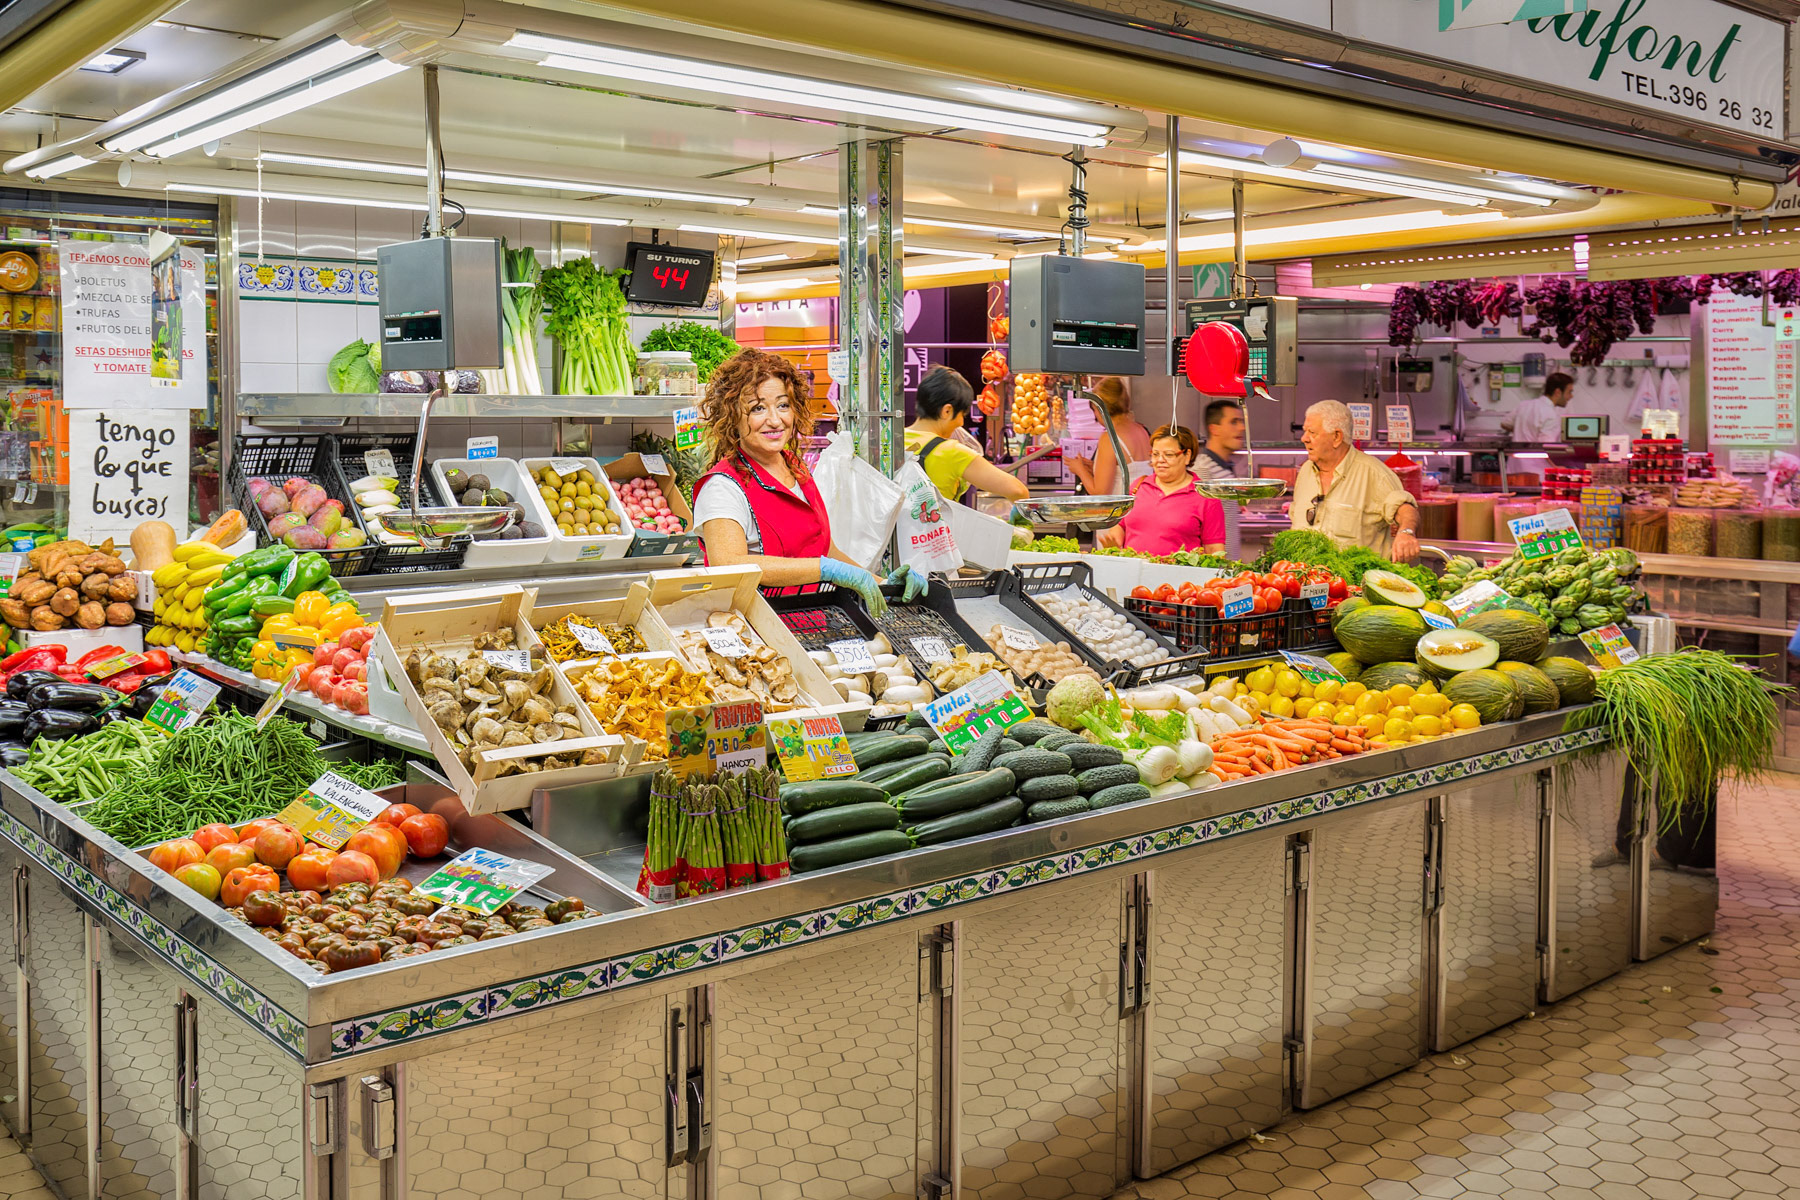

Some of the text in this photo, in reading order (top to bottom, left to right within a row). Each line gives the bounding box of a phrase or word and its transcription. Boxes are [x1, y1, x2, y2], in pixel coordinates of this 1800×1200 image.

[1621, 71, 1774, 130] TEL.396 26 32
[70, 253, 120, 264] TENEMOS
[665, 256, 700, 266] TURNO
[80, 277, 127, 288] BOLETUS
[652, 266, 690, 290] 44
[81, 292, 122, 304] MEZCLA
[125, 294, 140, 304] DE
[81, 309, 121, 320] TRUFAS
[81, 325, 121, 335] FRUTOS
[124, 326, 142, 336] DEL
[75, 346, 106, 356] SETAS
[94, 363, 147, 373] Y TOMATE
[96, 413, 175, 460] tengo
[94, 445, 172, 496] lo que
[93, 483, 168, 519] buscas
[1512, 519, 1545, 535] Frutas
[170, 671, 199, 694] Frutas
[714, 702, 763, 730] FRUTAS
[926, 692, 971, 724] Frutas
[804, 717, 843, 738] FRUTAS
[708, 737, 739, 760] 2'60
[826, 765, 854, 774] KILO
[323, 772, 362, 796] TOMATES
[323, 787, 373, 818] VALENCIANOS
[315, 831, 340, 847] KILO
[459, 850, 511, 869] Frutas
